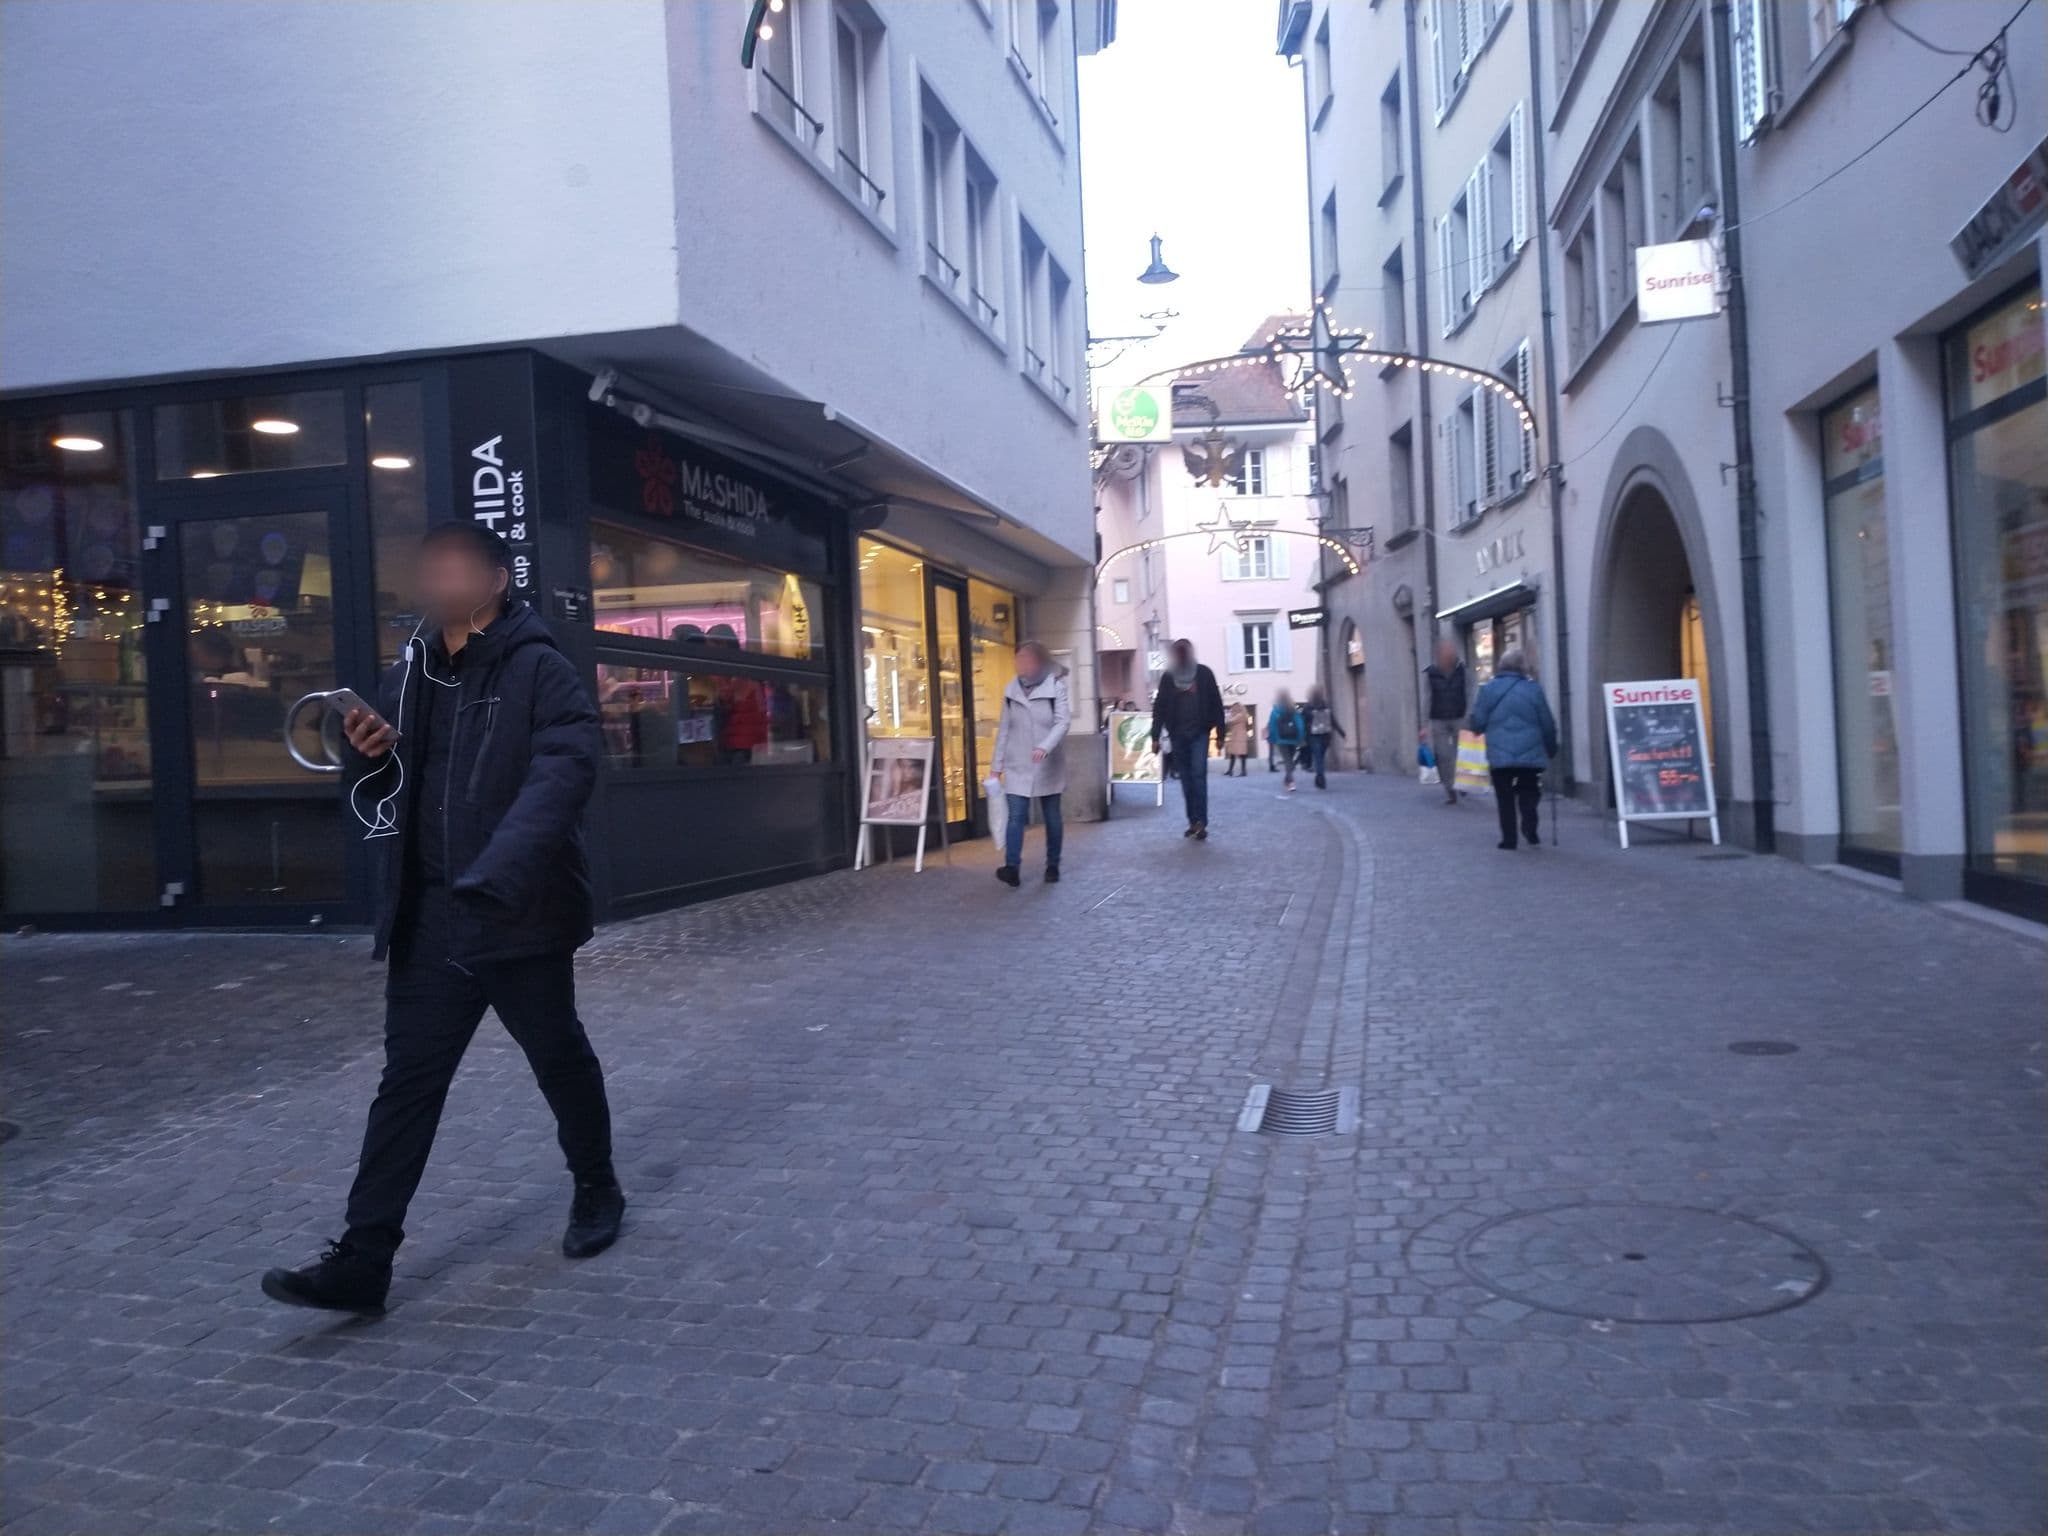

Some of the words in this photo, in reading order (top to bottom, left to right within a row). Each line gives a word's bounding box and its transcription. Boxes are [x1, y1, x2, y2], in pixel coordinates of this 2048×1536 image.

[1645, 271, 1714, 291] Sunrise
[471, 434, 507, 538] HIDA
[507, 469, 525, 516] cook
[682, 460, 769, 523] MASHIDA
[510, 522, 527, 541] &
[513, 555, 531, 588] cup
[1612, 686, 1693, 704] Sunrise
